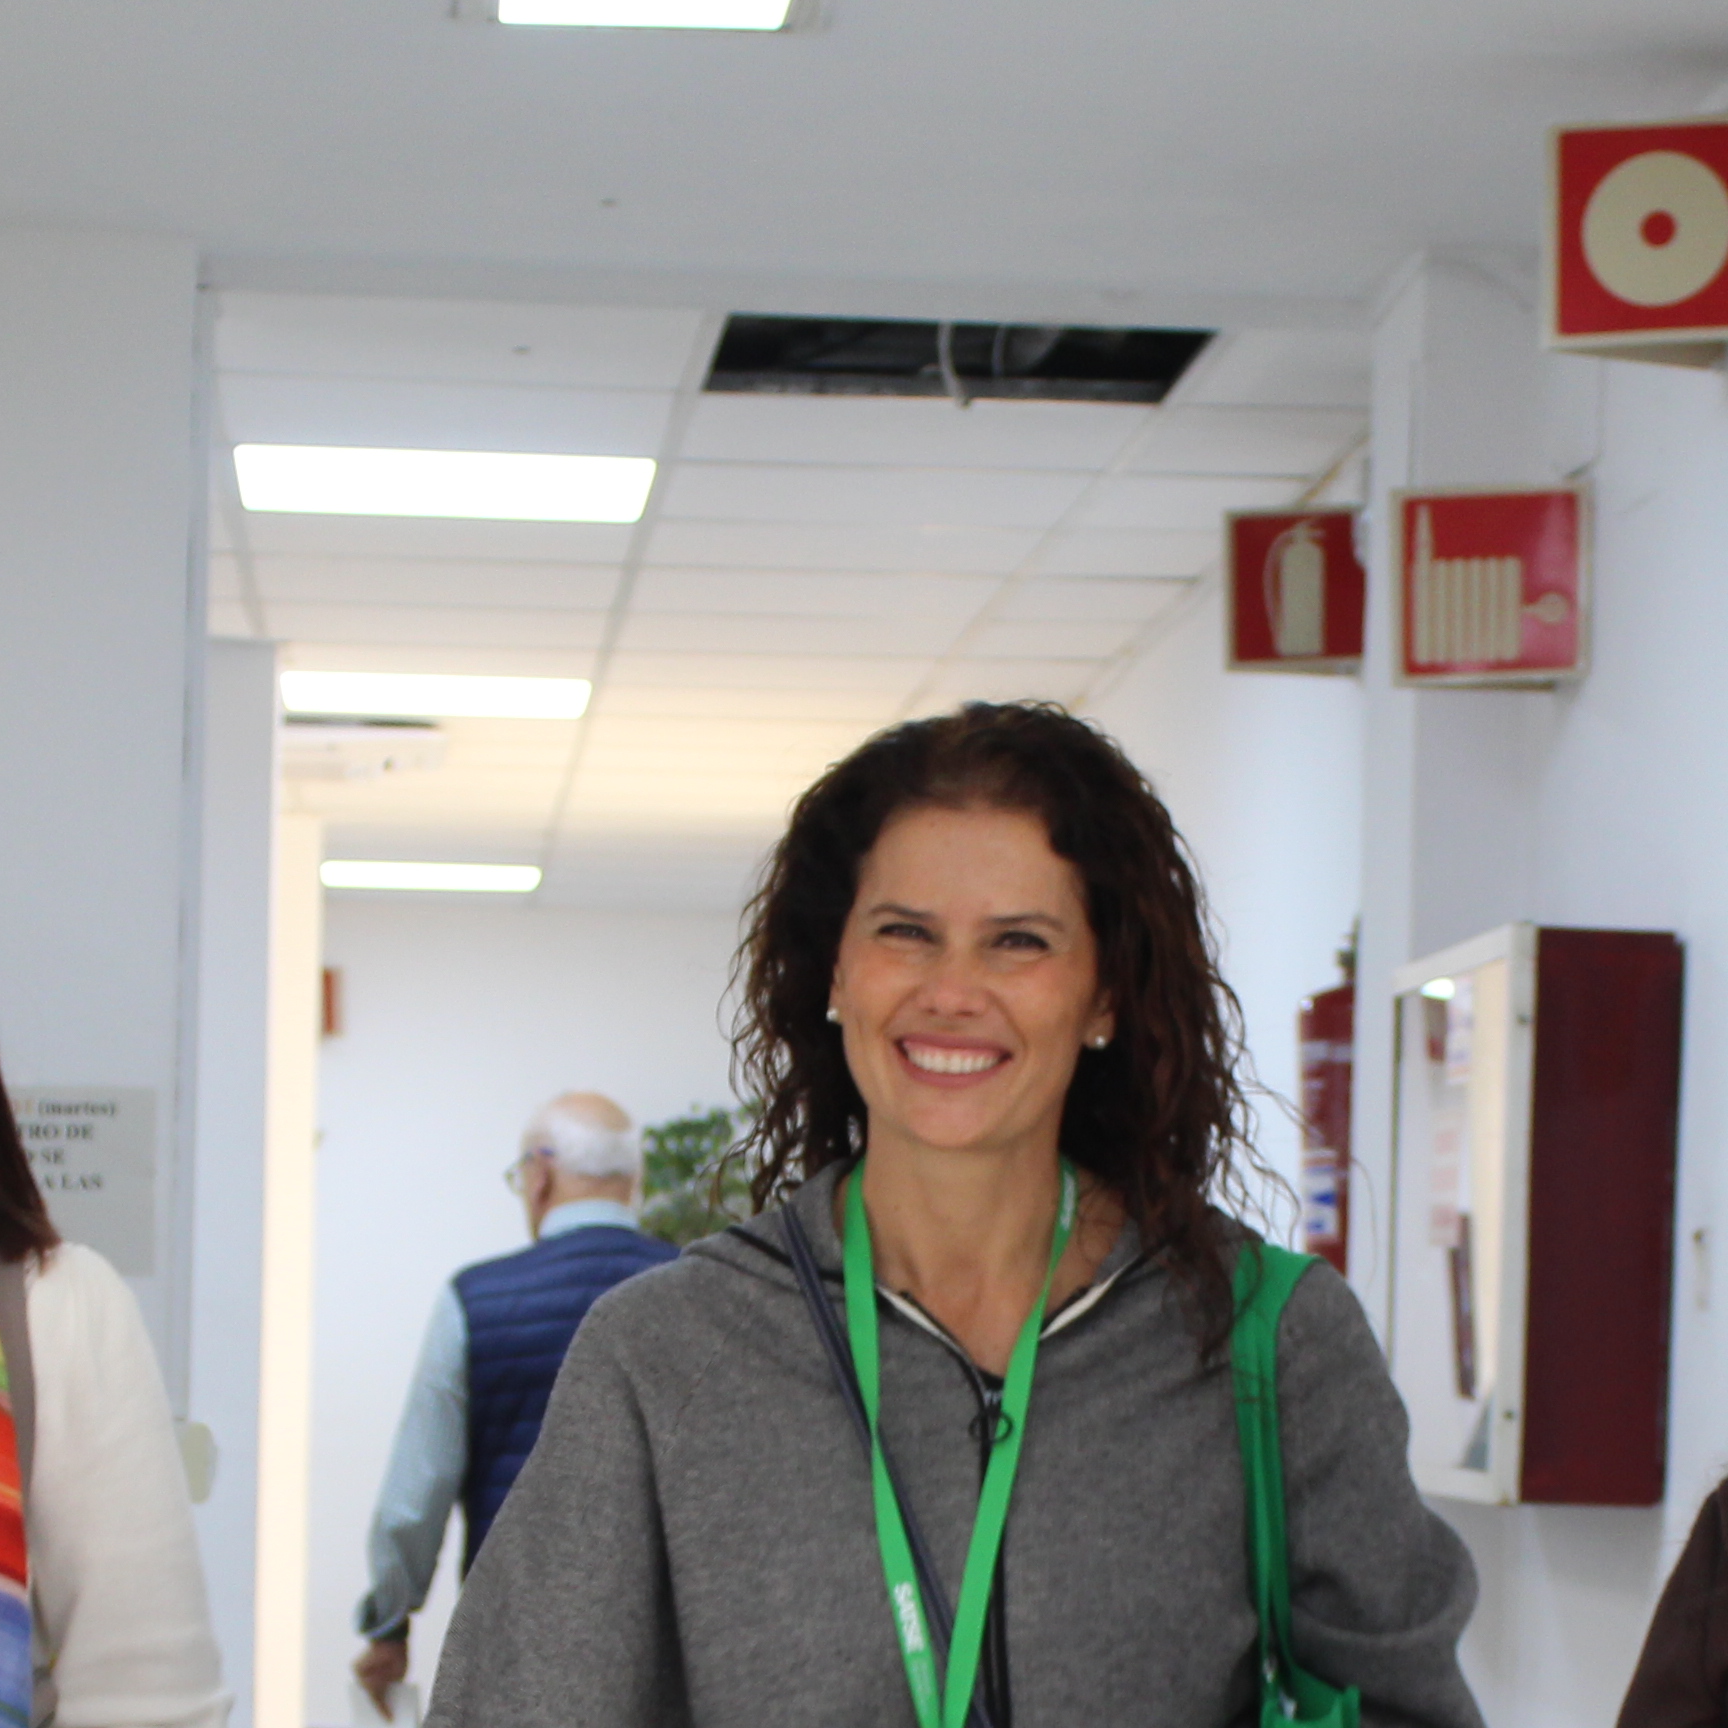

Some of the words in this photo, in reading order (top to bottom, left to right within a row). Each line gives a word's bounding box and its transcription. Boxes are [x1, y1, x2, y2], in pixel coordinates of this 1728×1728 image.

[67, 1124, 93, 1139] DE
[41, 1148, 64, 1164] SE
[61, 1173, 103, 1189] LAS
[894, 1582, 925, 1653] SATSE
